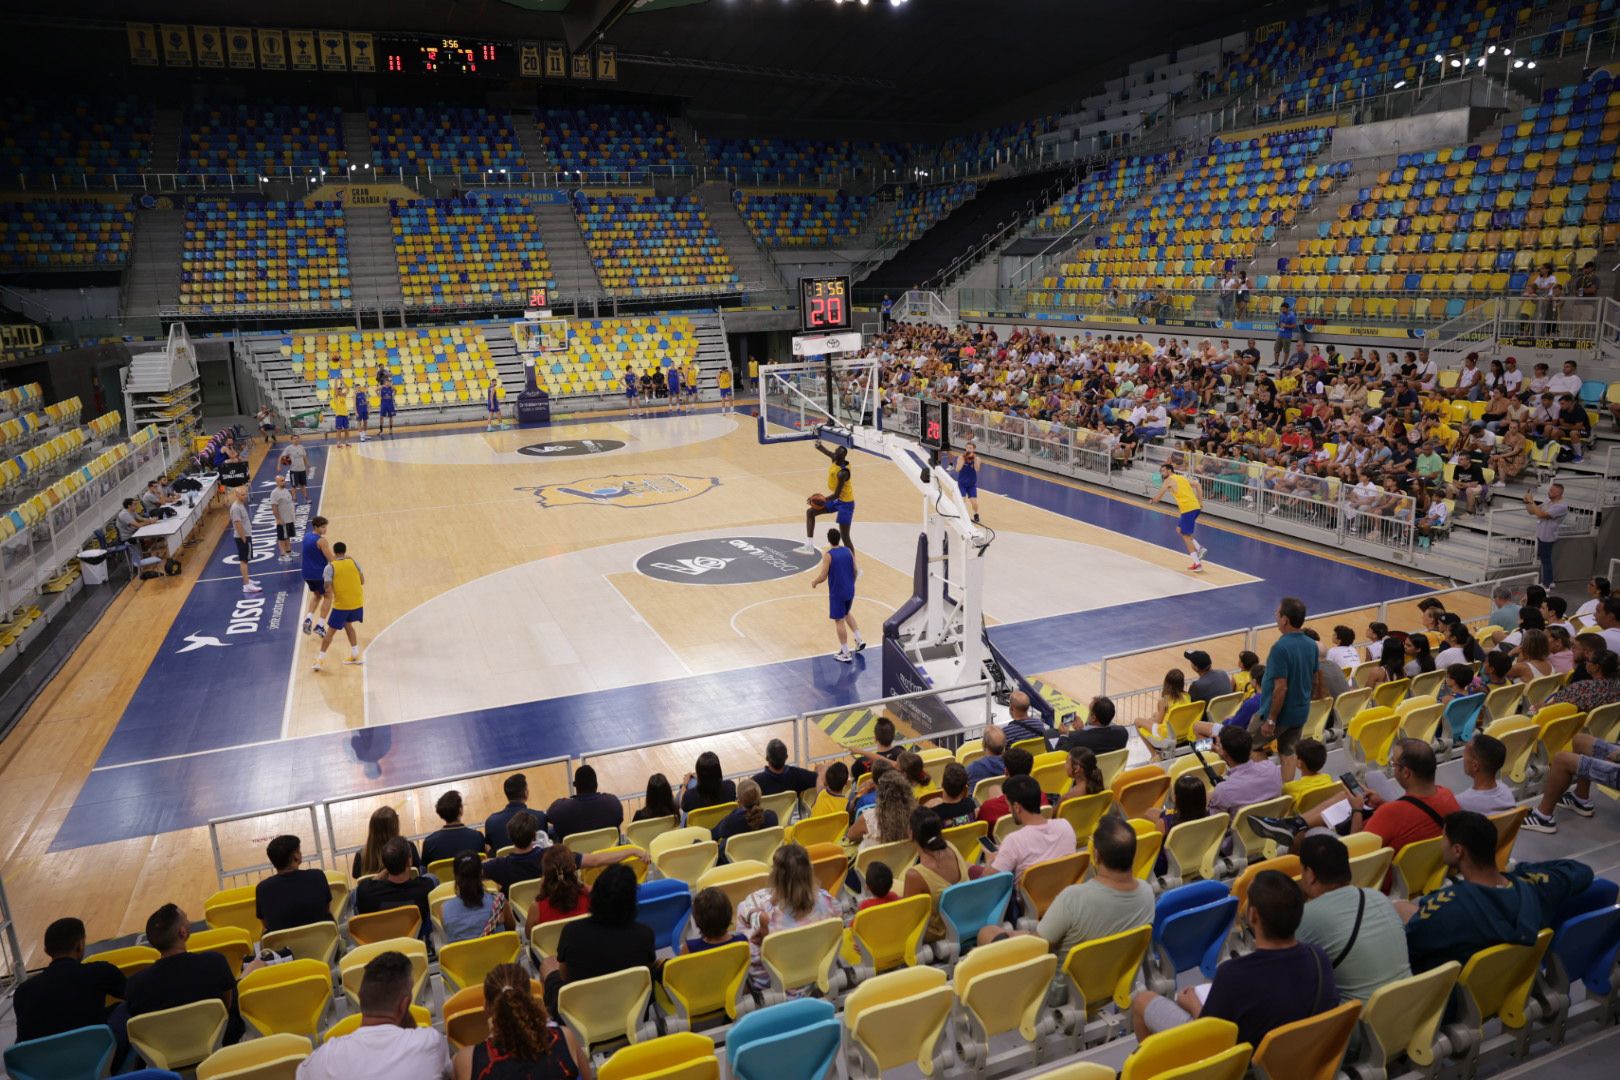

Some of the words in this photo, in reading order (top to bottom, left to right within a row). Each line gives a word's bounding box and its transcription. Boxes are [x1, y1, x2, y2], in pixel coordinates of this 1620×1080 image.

[442, 40, 458, 49] 3:56
[523, 56, 537, 70] 20
[550, 57, 560, 71] 11
[815, 281, 844, 297] 3:56
[529, 295, 545, 306] 20
[810, 297, 842, 325] 20
[927, 420, 941, 440] 20
